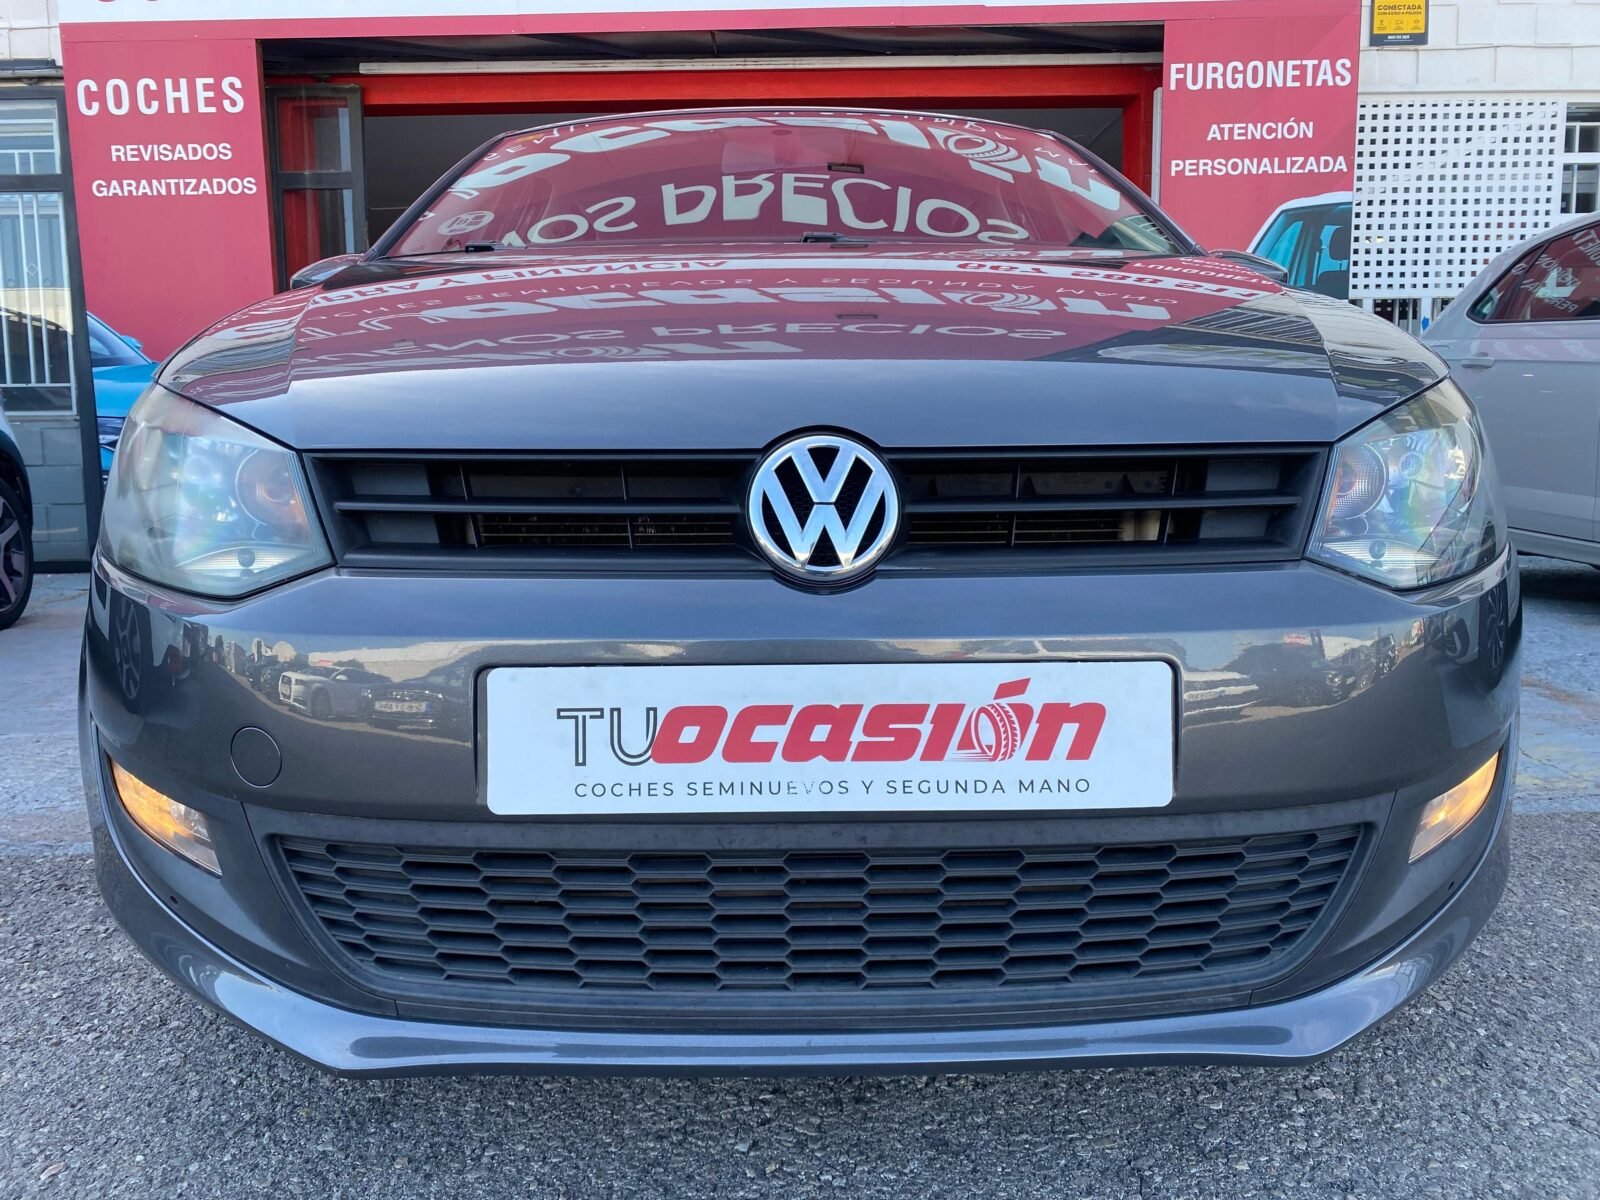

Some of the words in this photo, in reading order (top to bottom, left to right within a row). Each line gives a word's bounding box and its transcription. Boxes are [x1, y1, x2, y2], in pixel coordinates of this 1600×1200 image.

[1169, 58, 1352, 91] FURGONETAS
[76, 76, 245, 116] COCHES
[1206, 117, 1314, 141] ATENCIÓN
[111, 143, 232, 162] REVISADOS
[1170, 155, 1348, 177] PERSONALIZADA
[92, 177, 257, 197] GARANTIZADOS
[574, 782, 674, 798] COCHES
[686, 780, 849, 796] SEMINUEVOS
[861, 780, 874, 794] Y
[886, 779, 1006, 795] SEGUNDA
[1018, 778, 1090, 793] MANO
